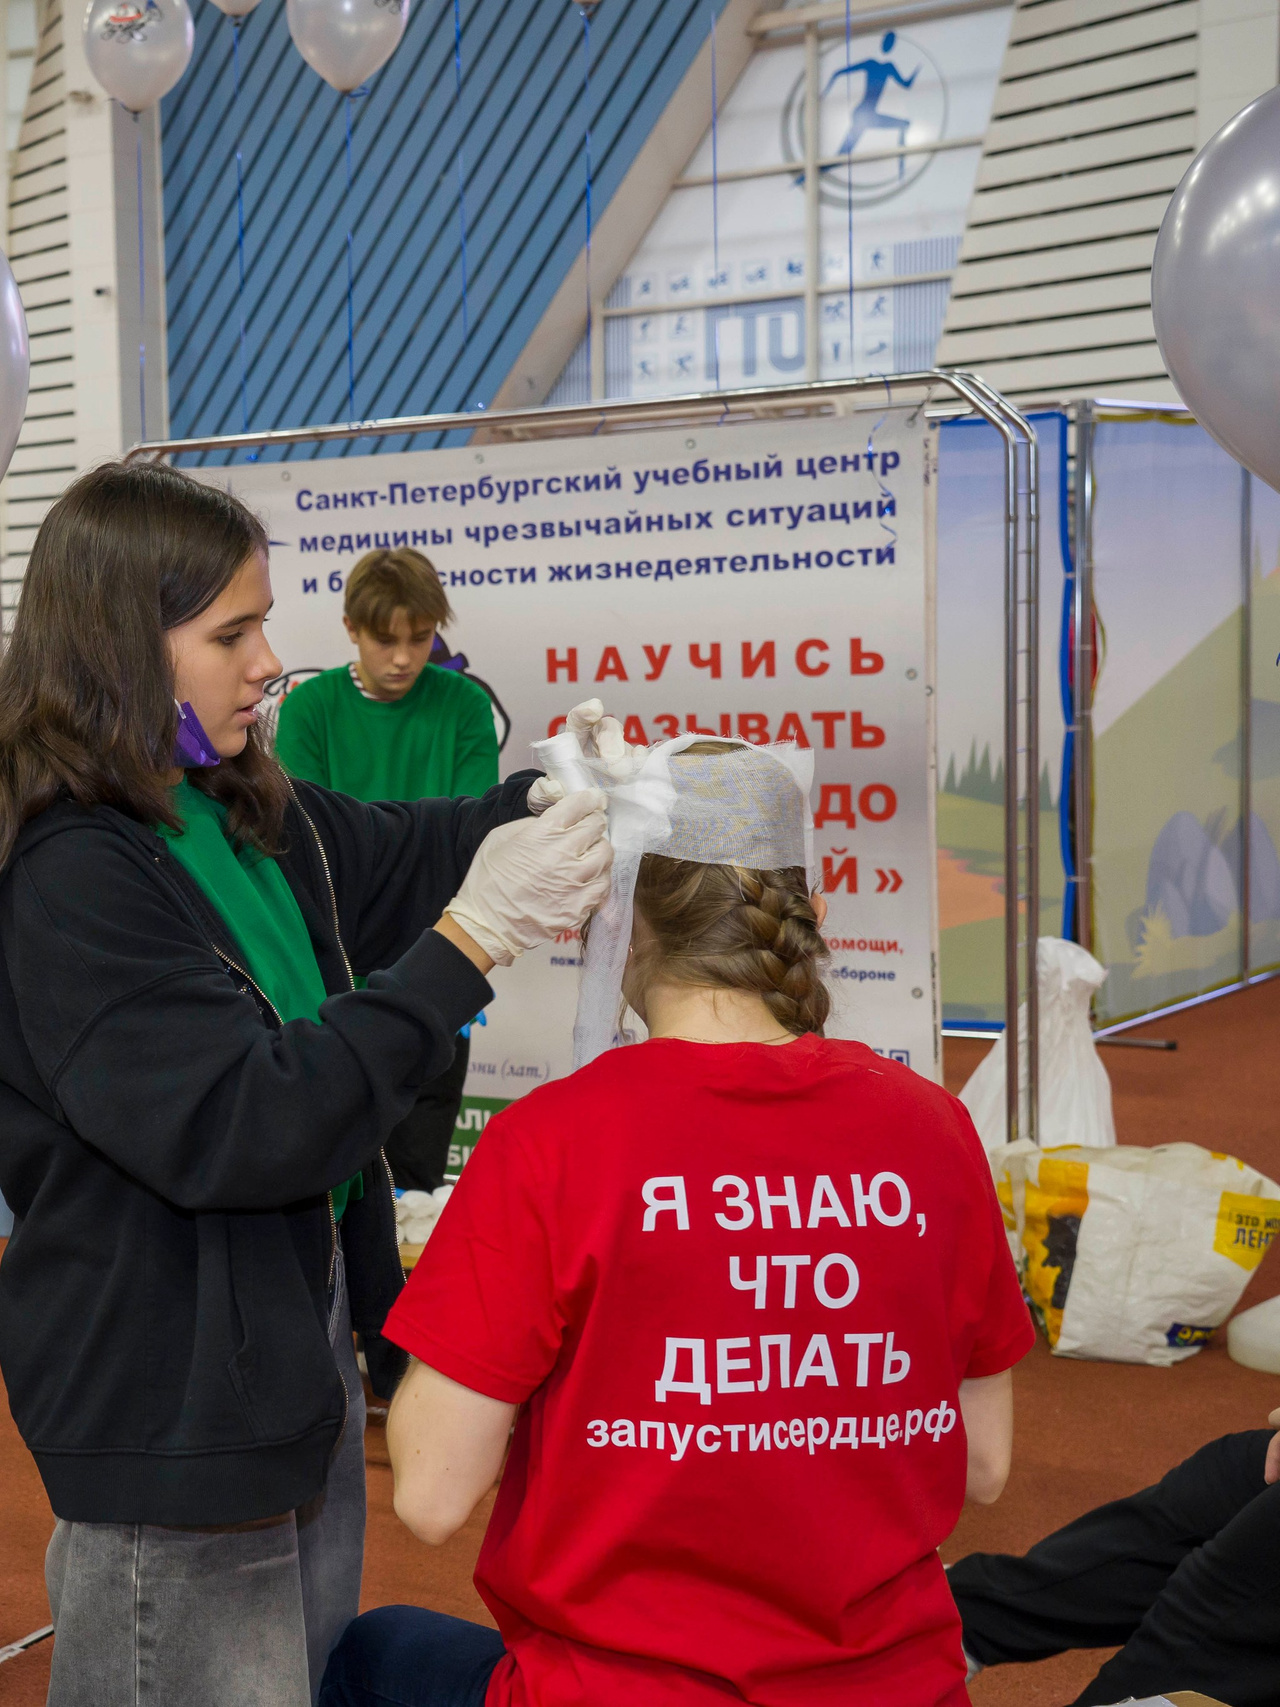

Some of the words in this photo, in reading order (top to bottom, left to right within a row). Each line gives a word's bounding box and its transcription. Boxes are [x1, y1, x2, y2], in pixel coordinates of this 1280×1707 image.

[296, 465, 622, 512] Санкт-Петербургский
[633, 454, 784, 495] учебный
[796, 449, 901, 478] центр
[299, 525, 454, 555] медицины
[464, 509, 714, 549] чрезвычайных
[726, 492, 897, 531] ситуаций
[302, 577, 318, 594] и
[328, 566, 537, 593] бсности
[547, 546, 896, 583] жизнедеятельности
[546, 637, 885, 684] НАУЧИСЬ
[641, 1175, 690, 1232] Я
[712, 1171, 927, 1238] ЗНАЮ,
[729, 1252, 860, 1310] ЧТО
[654, 1331, 911, 1406] ДЕЛАТЬ
[586, 1400, 957, 1462] запустисердце.рф
